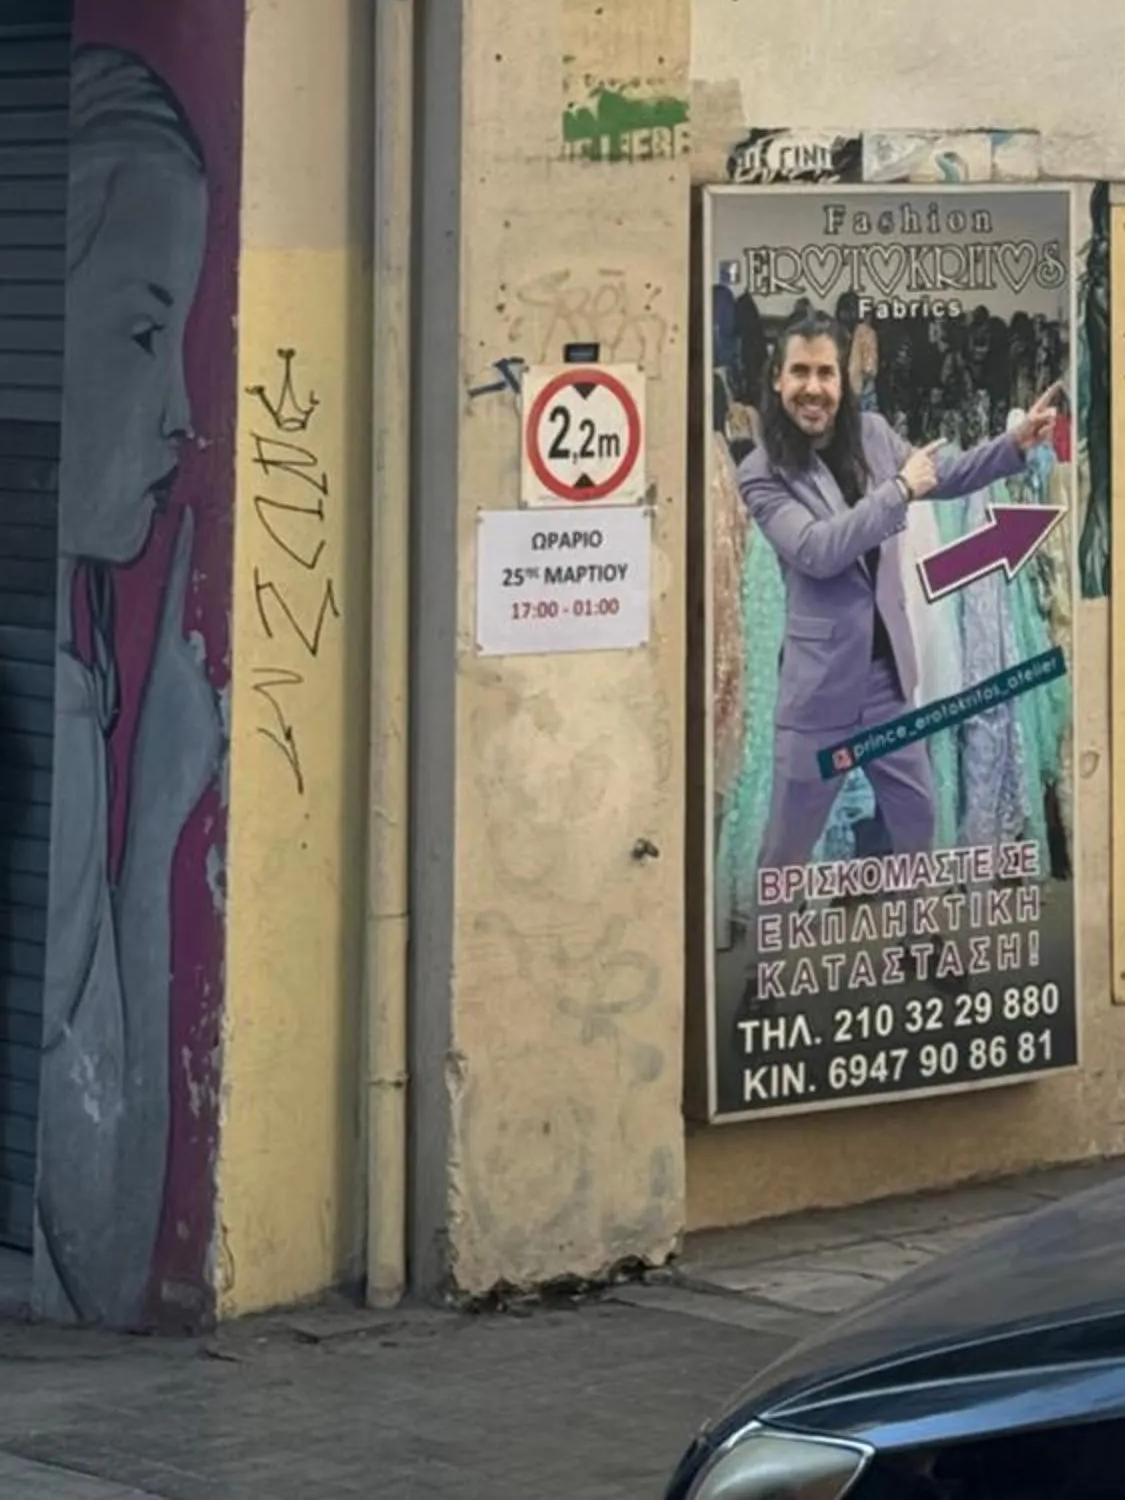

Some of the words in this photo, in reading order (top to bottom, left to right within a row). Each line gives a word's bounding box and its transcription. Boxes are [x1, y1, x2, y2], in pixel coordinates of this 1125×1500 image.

[823, 203, 993, 235] Fashion
[858, 295, 962, 320] Fabrics
[531, 529, 603, 550] ΩΡΑΡΙΟ
[544, 563, 628, 585] ΜΑΡΤΙΟΥ
[512, 600, 559, 619] 17:00
[572, 597, 620, 616] 01:00
[758, 845, 993, 905] ΒΡΙΣΚΟΜΑΣΤΕ
[1001, 840, 1040, 877] ΣΕ
[758, 885, 1040, 952] ΕΚΠΛΗΚΤΙΚΗ
[758, 930, 1040, 999] ΚΑΤΑΣΤΑΣΗ!
[738, 1017, 822, 1053] ΤΗΛ.
[834, 1004, 894, 1043] 210
[905, 998, 943, 1033] 32
[954, 991, 992, 1028] 29
[1003, 982, 1060, 1021] 880
[743, 1061, 816, 1101] ΚΙΝ.
[828, 1049, 908, 1089] 6947
[919, 1042, 958, 1077] 90
[969, 1036, 1007, 1070] 86
[1018, 1029, 1053, 1063] 81
